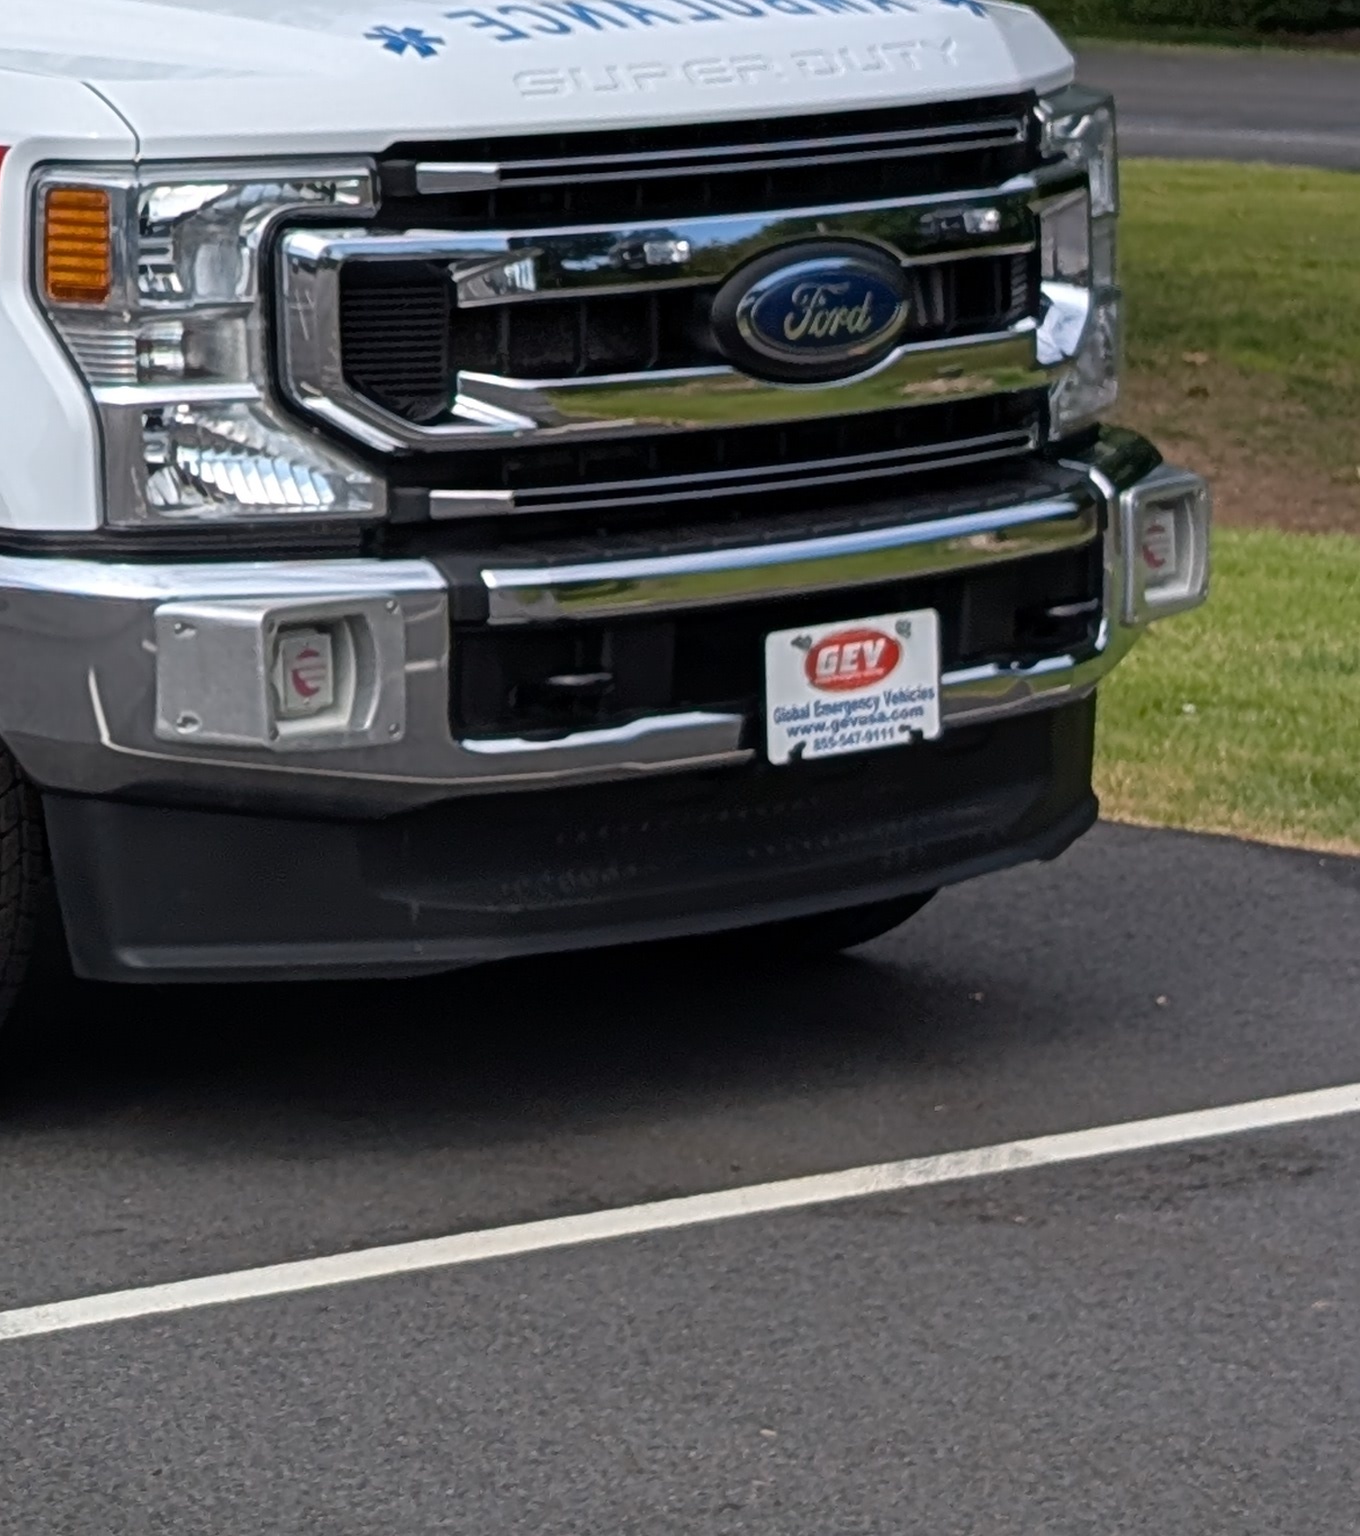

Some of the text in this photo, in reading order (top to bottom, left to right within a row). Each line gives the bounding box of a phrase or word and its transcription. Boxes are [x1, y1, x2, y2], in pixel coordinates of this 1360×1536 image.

[512, 36, 960, 100] SUPER DUTY
[783, 281, 874, 340] Ford
[815, 637, 888, 678] GEV
[773, 684, 935, 724] Global Emergency Vehicles
